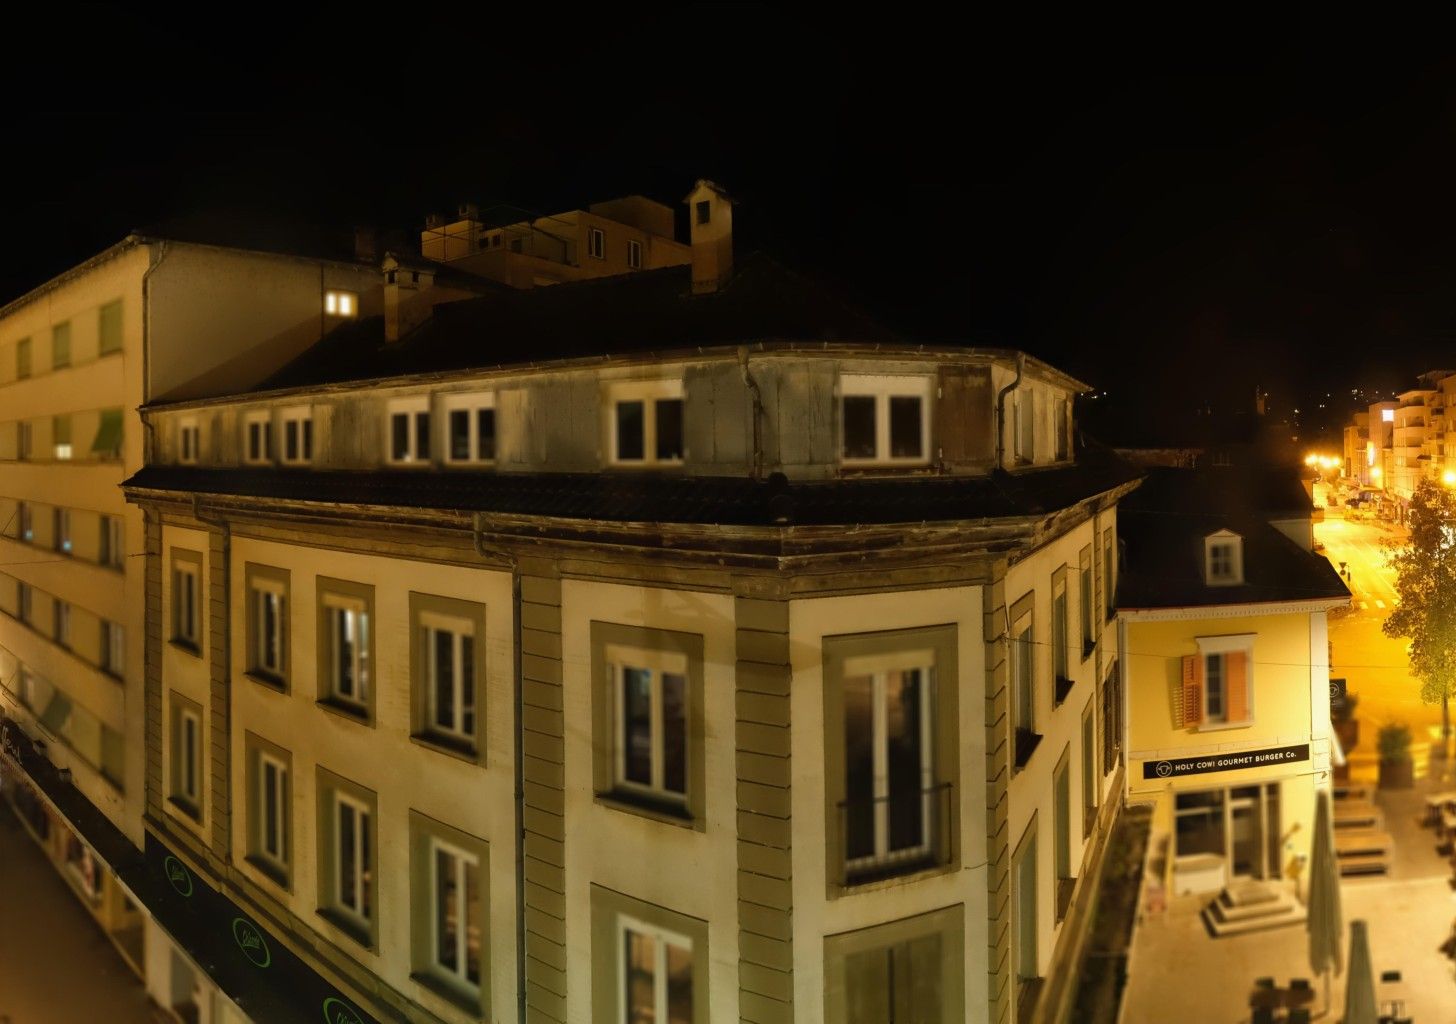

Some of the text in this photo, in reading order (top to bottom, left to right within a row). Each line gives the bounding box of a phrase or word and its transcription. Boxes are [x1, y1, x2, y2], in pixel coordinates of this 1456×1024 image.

[1175, 763, 1194, 771] HOLY
[1217, 756, 1253, 767] GOURMET
[1255, 752, 1284, 762] BURGER
